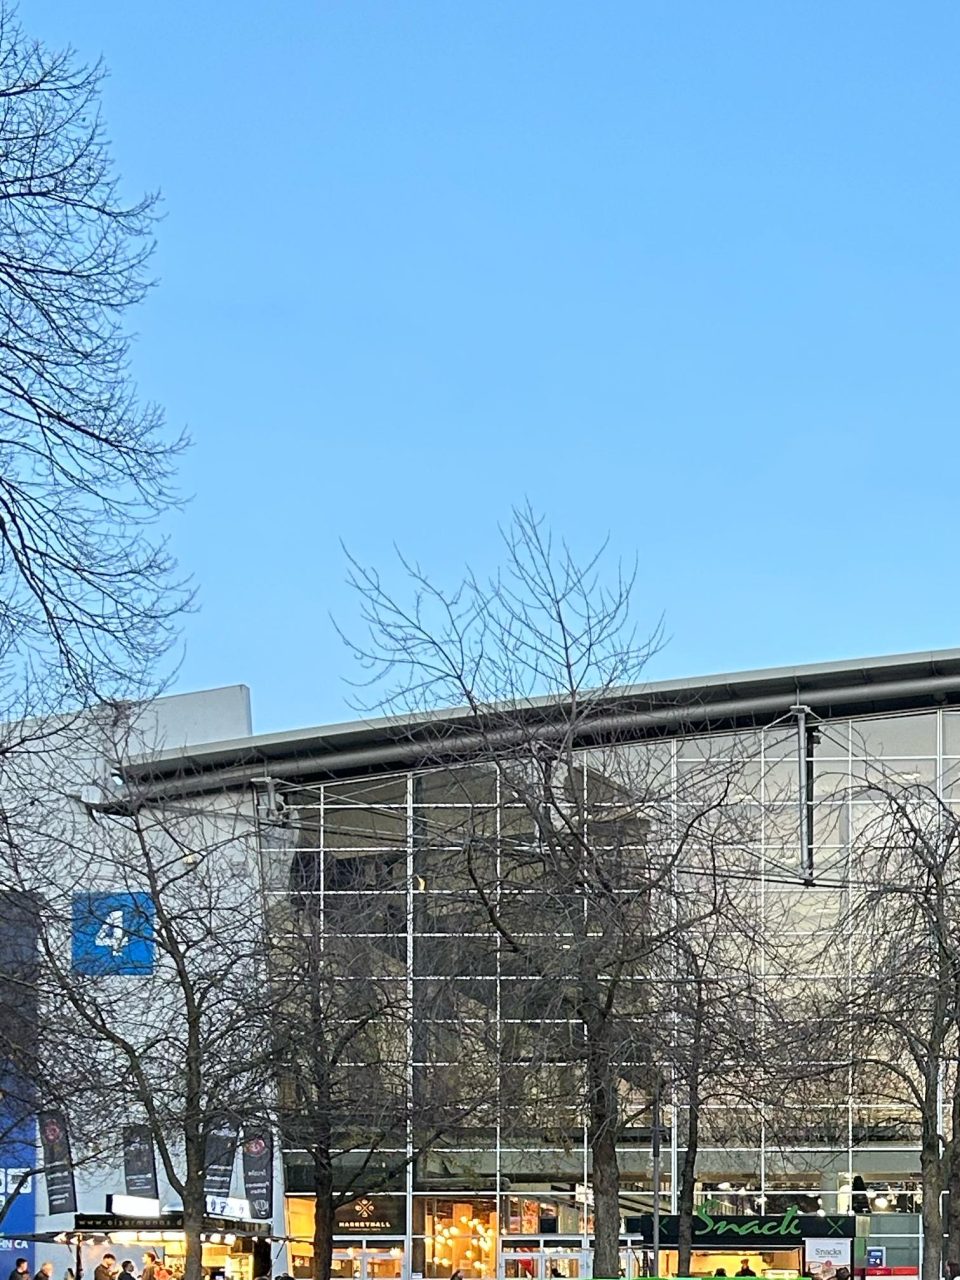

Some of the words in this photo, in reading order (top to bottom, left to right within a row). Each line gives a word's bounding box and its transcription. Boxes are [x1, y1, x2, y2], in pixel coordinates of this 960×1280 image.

[95, 910, 129, 957] 4
[694, 1199, 802, 1236] Snack
[815, 1247, 842, 1256] Snacks
